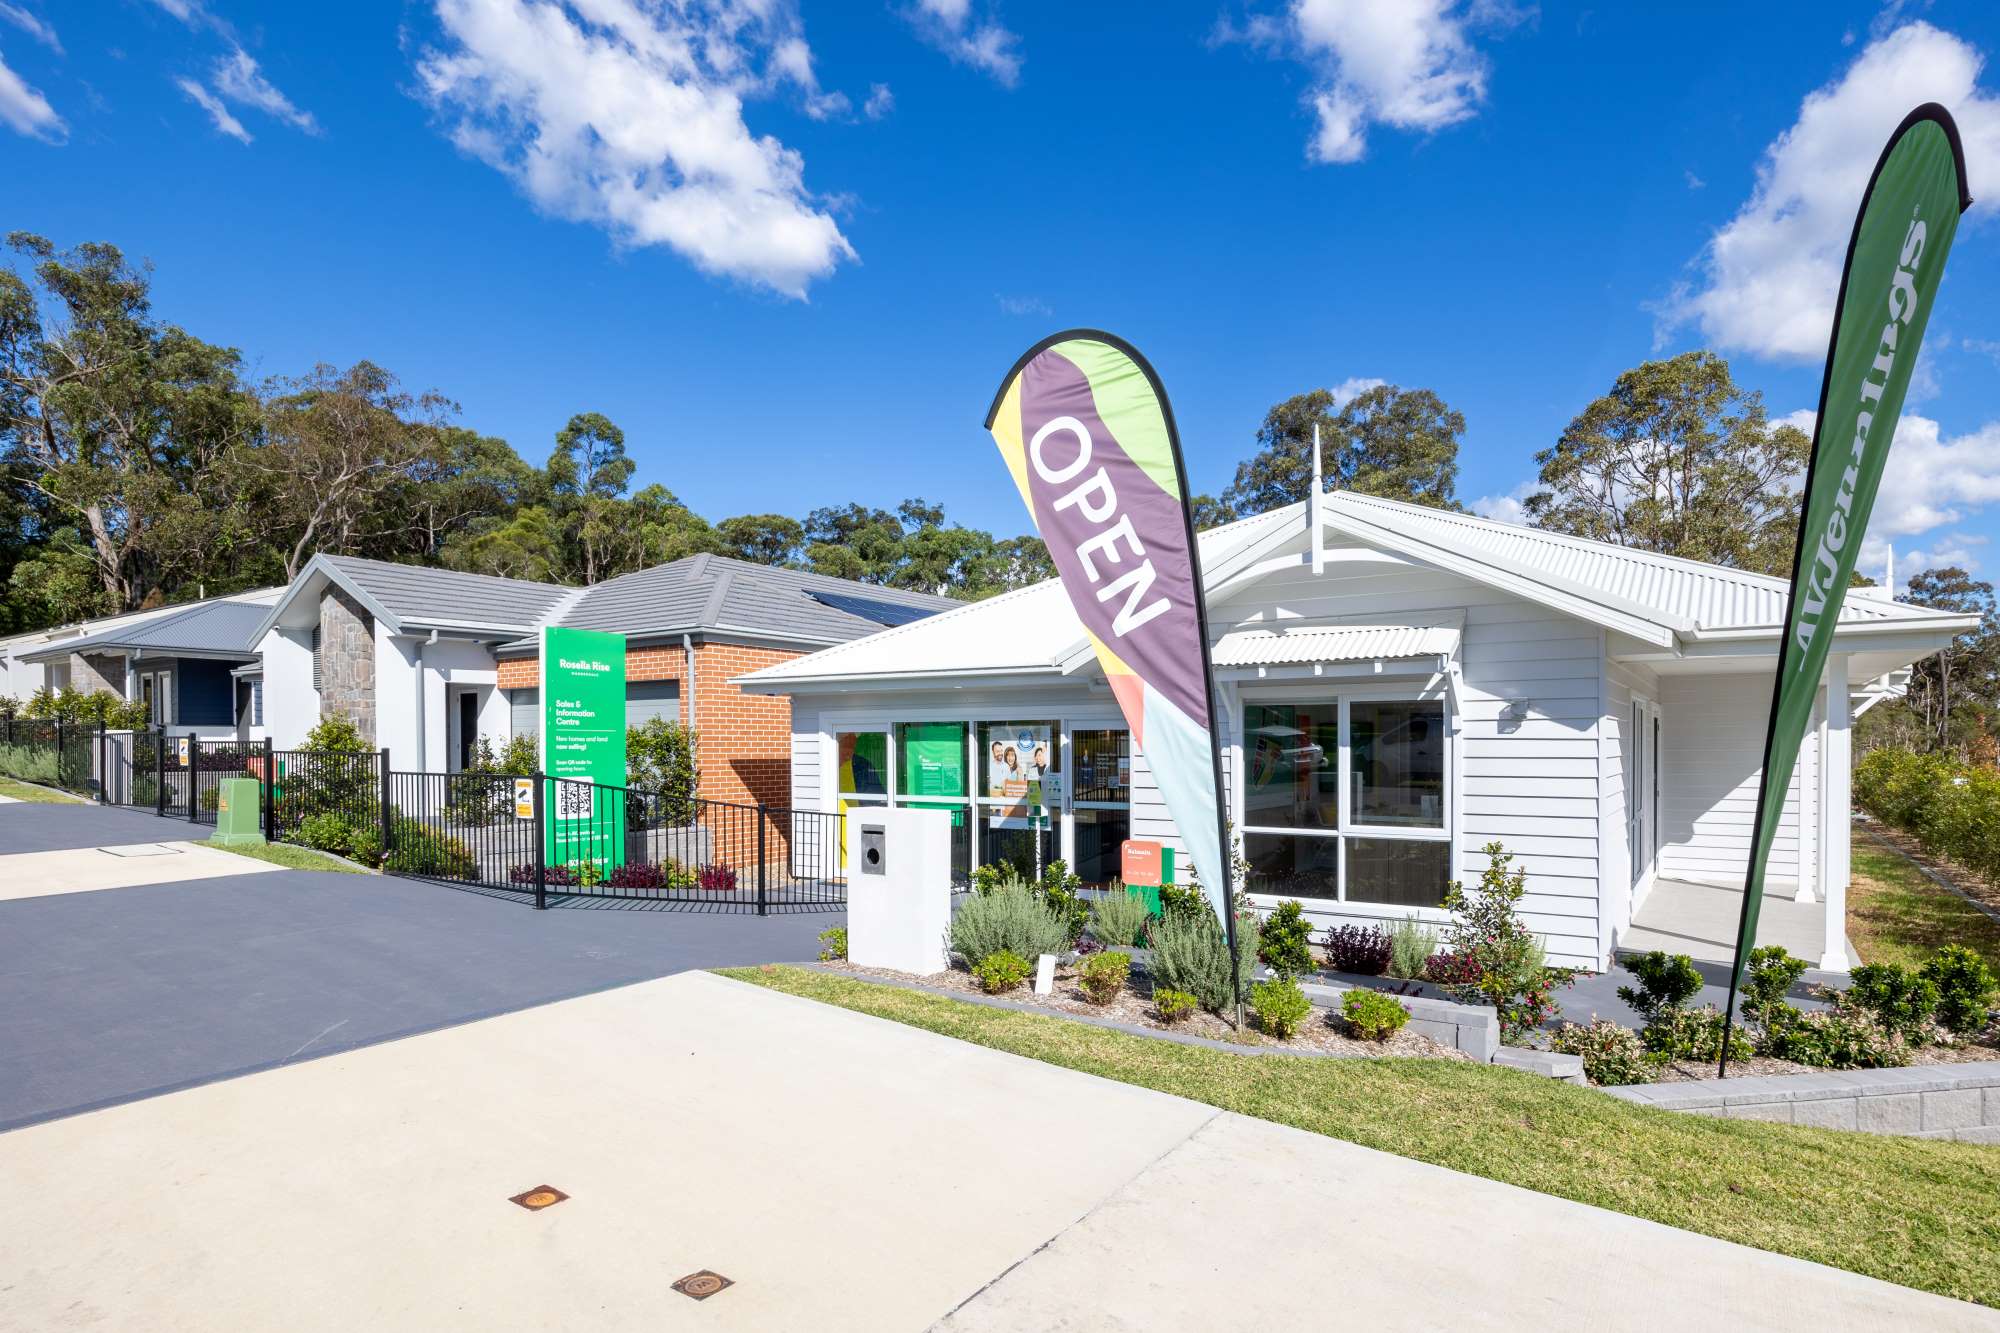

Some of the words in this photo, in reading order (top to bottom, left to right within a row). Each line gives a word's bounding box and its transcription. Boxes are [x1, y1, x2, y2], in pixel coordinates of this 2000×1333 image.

[1030, 416, 1172, 638] OPEN
[559, 658, 591, 670] Rosella
[591, 660, 610, 672] Rise
[555, 699, 574, 708] Sales
[555, 709, 596, 718] Information
[555, 717, 581, 726] Centre
